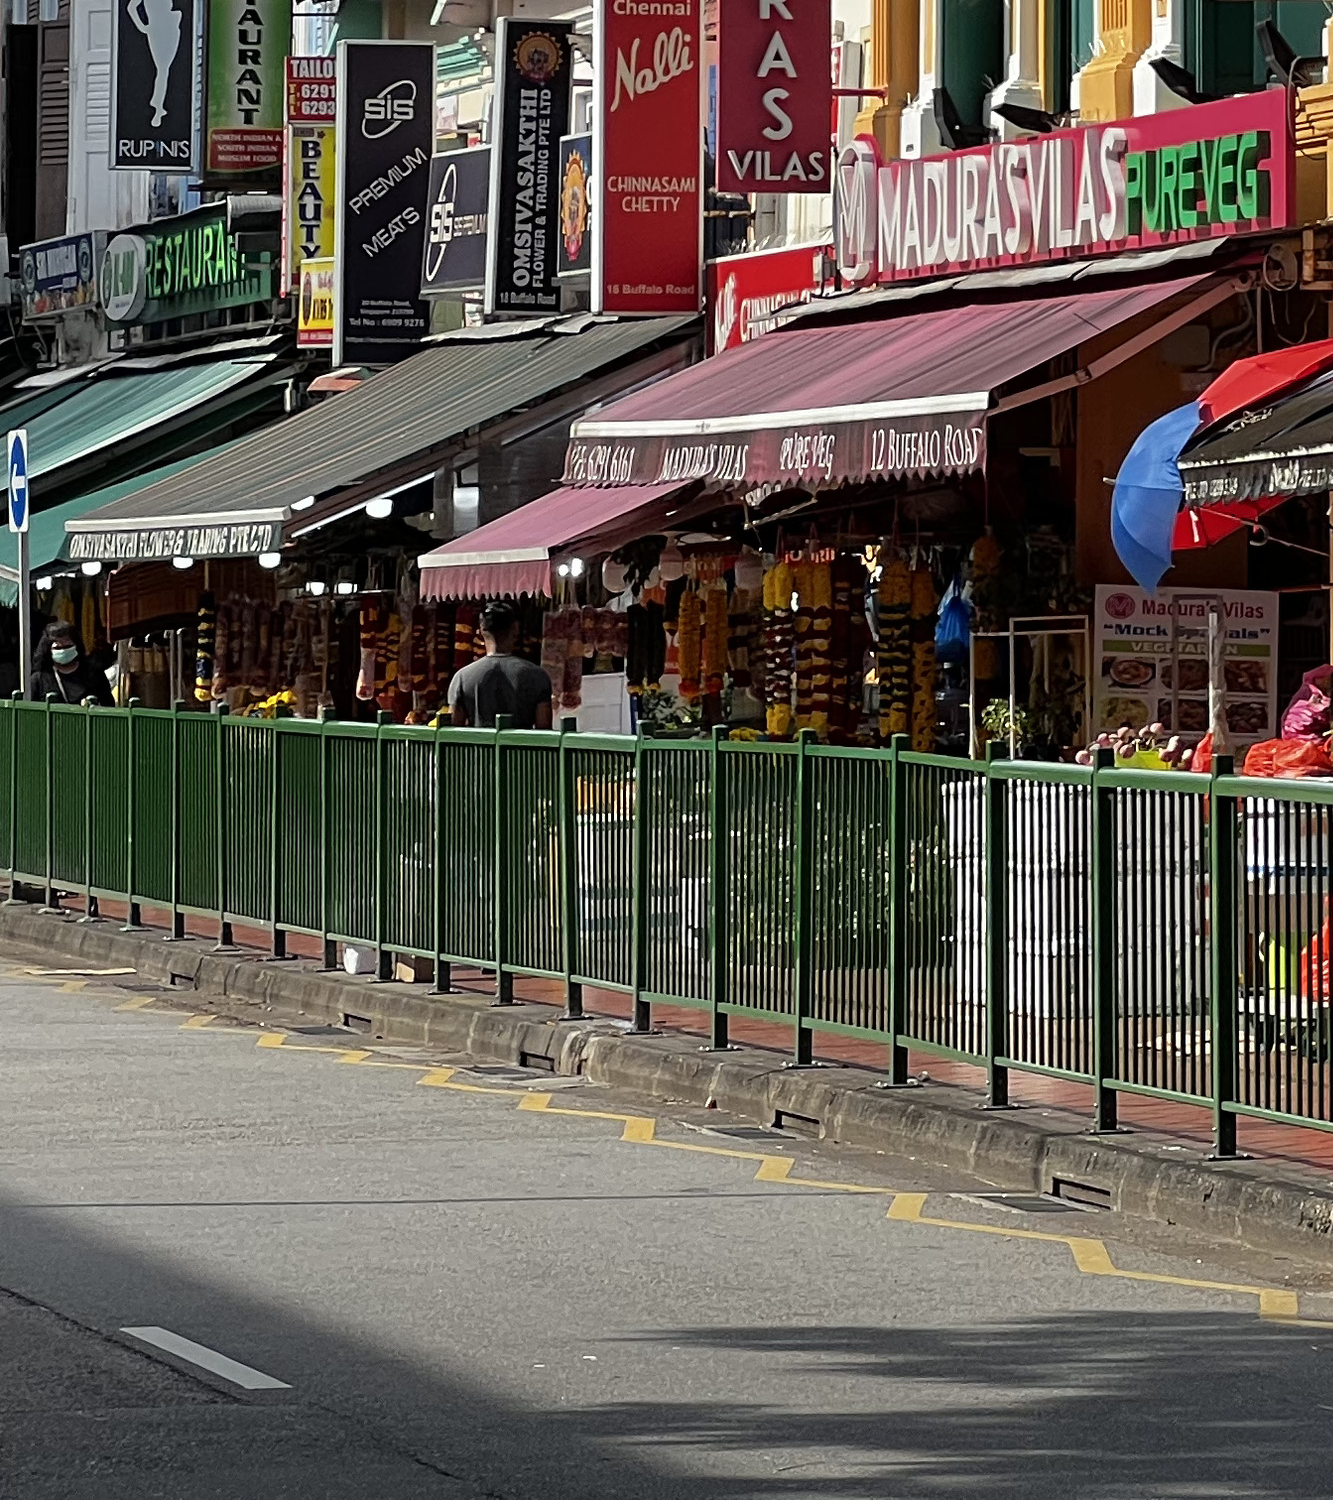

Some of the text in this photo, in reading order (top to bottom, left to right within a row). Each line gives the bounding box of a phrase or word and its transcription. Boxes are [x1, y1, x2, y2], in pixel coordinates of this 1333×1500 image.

[613, 0, 691, 15] Chennai
[290, 60, 336, 78] TAILO
[610, 27, 693, 112] Nalli
[349, 147, 428, 215] PREMIUM
[607, 176, 696, 193] CHINNASAMI
[728, 150, 825, 181] VILAS
[1125, 147, 1198, 234] PURE
[1198, 131, 1266, 224] VEG
[298, 140, 324, 259] BEAUTY
[512, 89, 538, 287] OMSIVASAKTHI
[532, 89, 552, 287] FLOWER & TRADING PTE LTD
[622, 197, 680, 212] CHETTY
[362, 206, 420, 257] MEATS
[146, 220, 246, 297] RESTAURAN
[623, 284, 663, 294] Buffalo
[666, 285, 695, 294] Road
[713, 445, 748, 481] VILAS
[871, 429, 885, 471] 12
[229, 525, 249, 553] PTE
